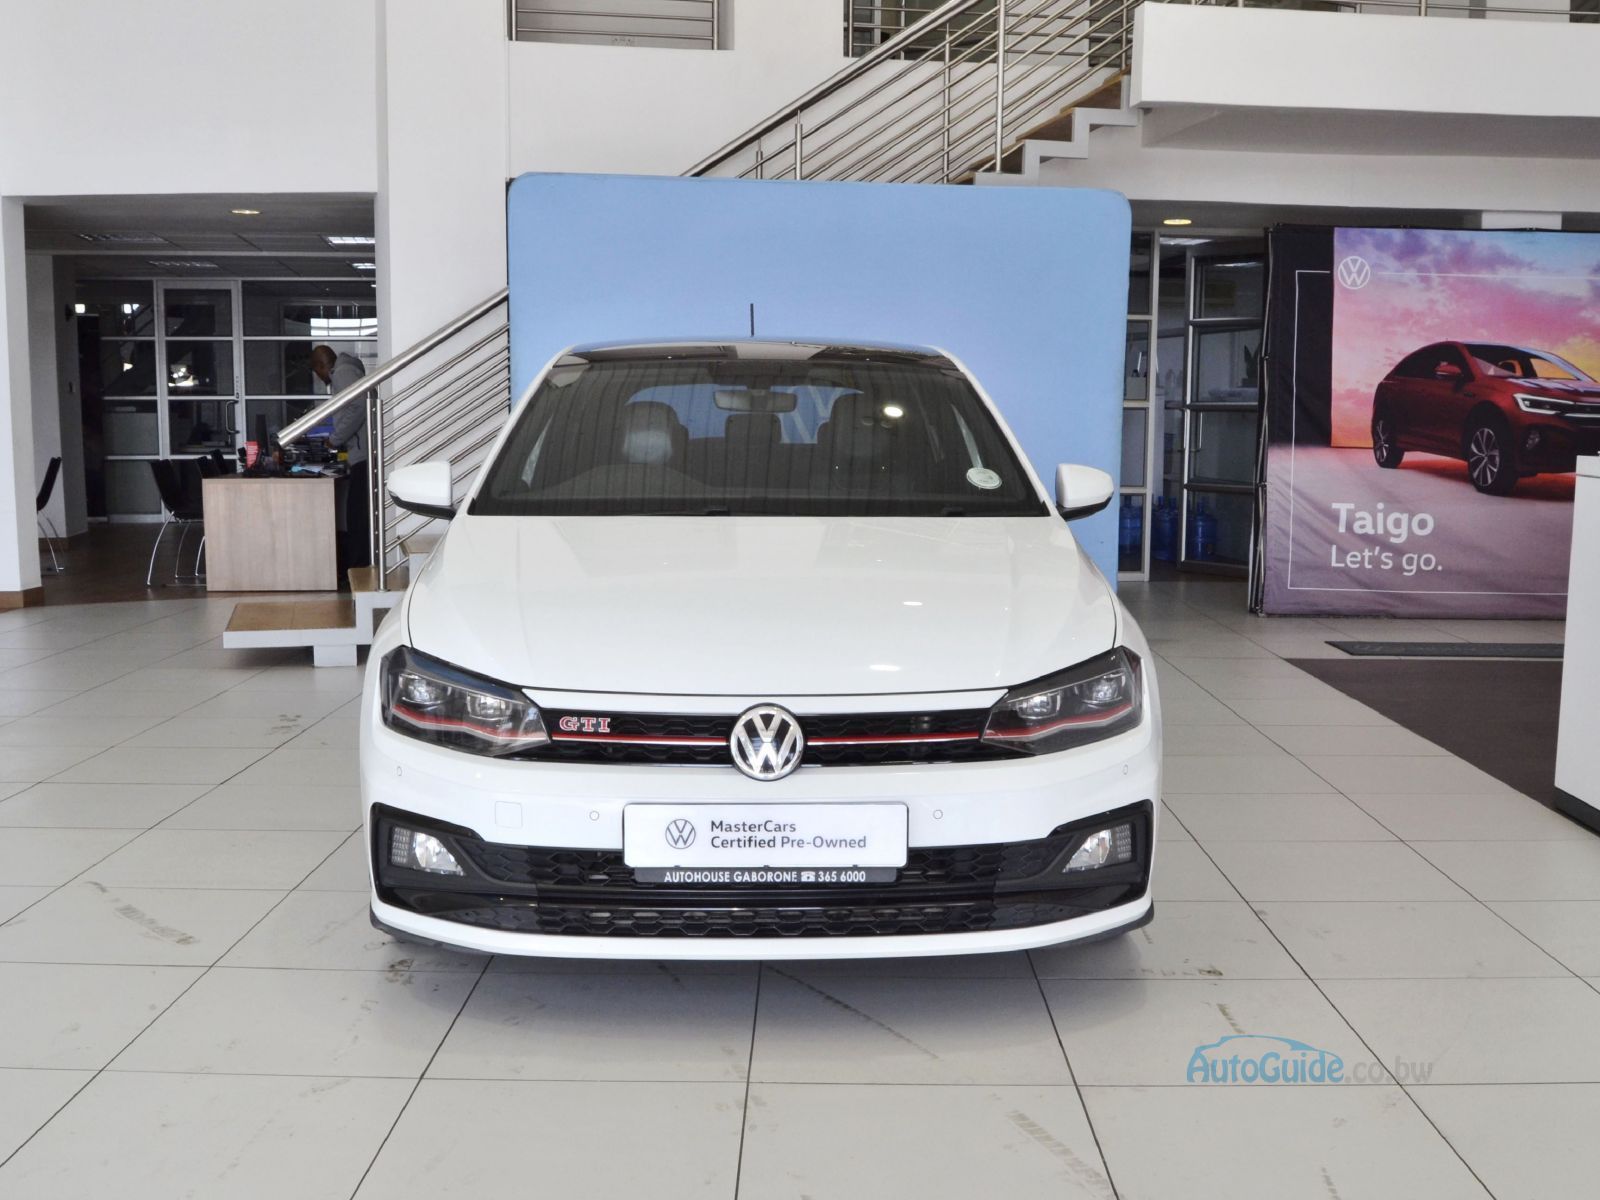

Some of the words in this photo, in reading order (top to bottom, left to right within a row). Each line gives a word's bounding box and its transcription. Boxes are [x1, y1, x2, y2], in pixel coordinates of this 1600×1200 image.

[1331, 502, 1434, 543] Taigo
[1331, 544, 1393, 570] Let's
[1402, 553, 1443, 576] go.
[559, 715, 611, 733] GTI
[710, 819, 797, 833] MasterCars
[710, 835, 776, 848] Certified
[781, 835, 867, 848] Pre-Owned
[663, 871, 730, 883] AUTOHOUSE
[733, 871, 798, 883] GABORONE
[817, 870, 838, 883] 365
[840, 870, 867, 883] 6000
